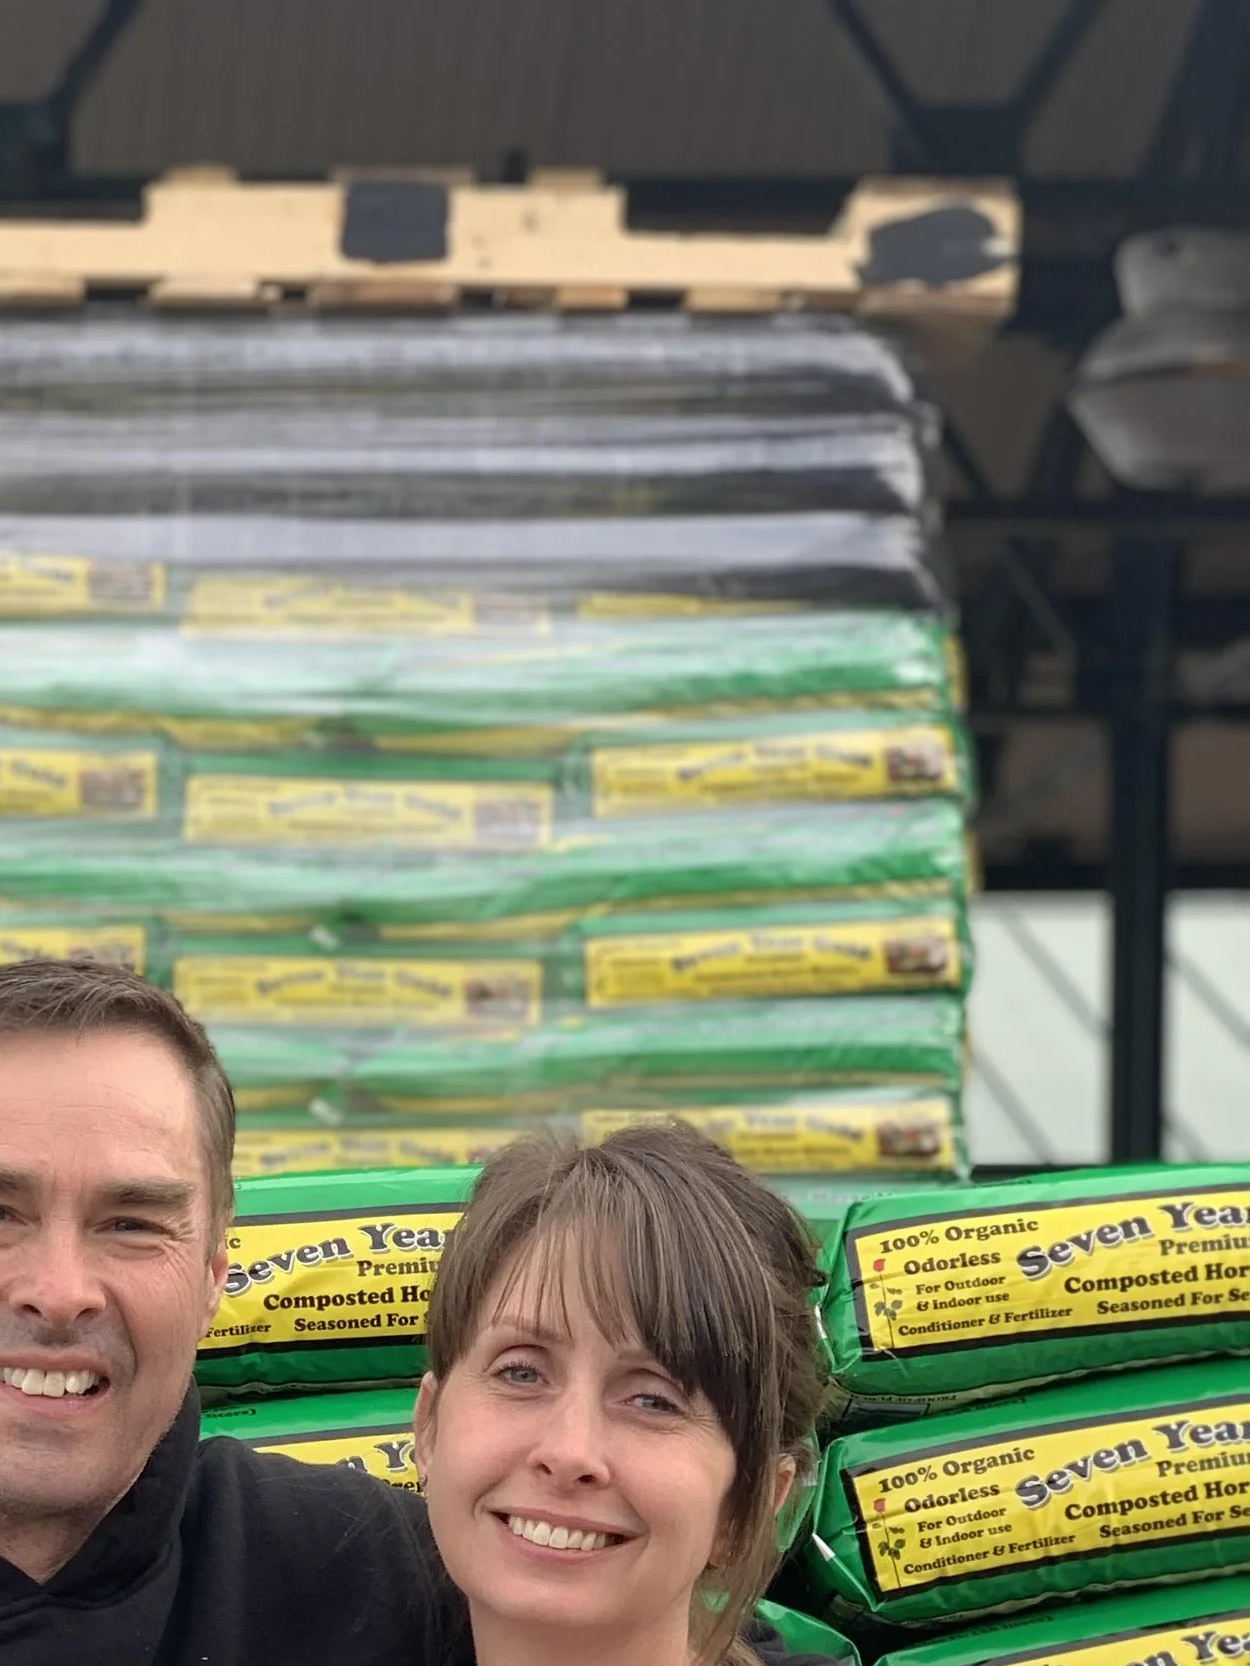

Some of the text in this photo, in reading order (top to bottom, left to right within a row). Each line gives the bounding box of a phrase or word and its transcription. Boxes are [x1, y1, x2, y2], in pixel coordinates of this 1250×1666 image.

[880, 1218, 1039, 1254] 100% Organic
[1017, 1216, 1155, 1282] Seven
[224, 1235, 353, 1297] Seven
[904, 1252, 1001, 1275] Odorless
[916, 1275, 1006, 1295] For Outdoor
[1064, 1266, 1198, 1294] Composted
[263, 1287, 394, 1312] Composted
[933, 1292, 1009, 1310] Indoor use
[1097, 1291, 1223, 1314] Seasoned For
[206, 1323, 272, 1338] Fertilizer
[294, 1313, 418, 1332] Seasoned For
[899, 1308, 1073, 1336] Conditioner Fertilizer
[878, 1447, 1035, 1493] 100% Organic
[1016, 1438, 1152, 1510] Seven
[905, 1484, 1001, 1513] Odorless
[1065, 1485, 1198, 1520] Composted
[917, 1507, 1007, 1532] For Outdoor
[1100, 1510, 1225, 1538] Seasoned For
[936, 1523, 1012, 1546] Indoor use
[904, 1534, 1075, 1575] Conditioner Fertilizer
